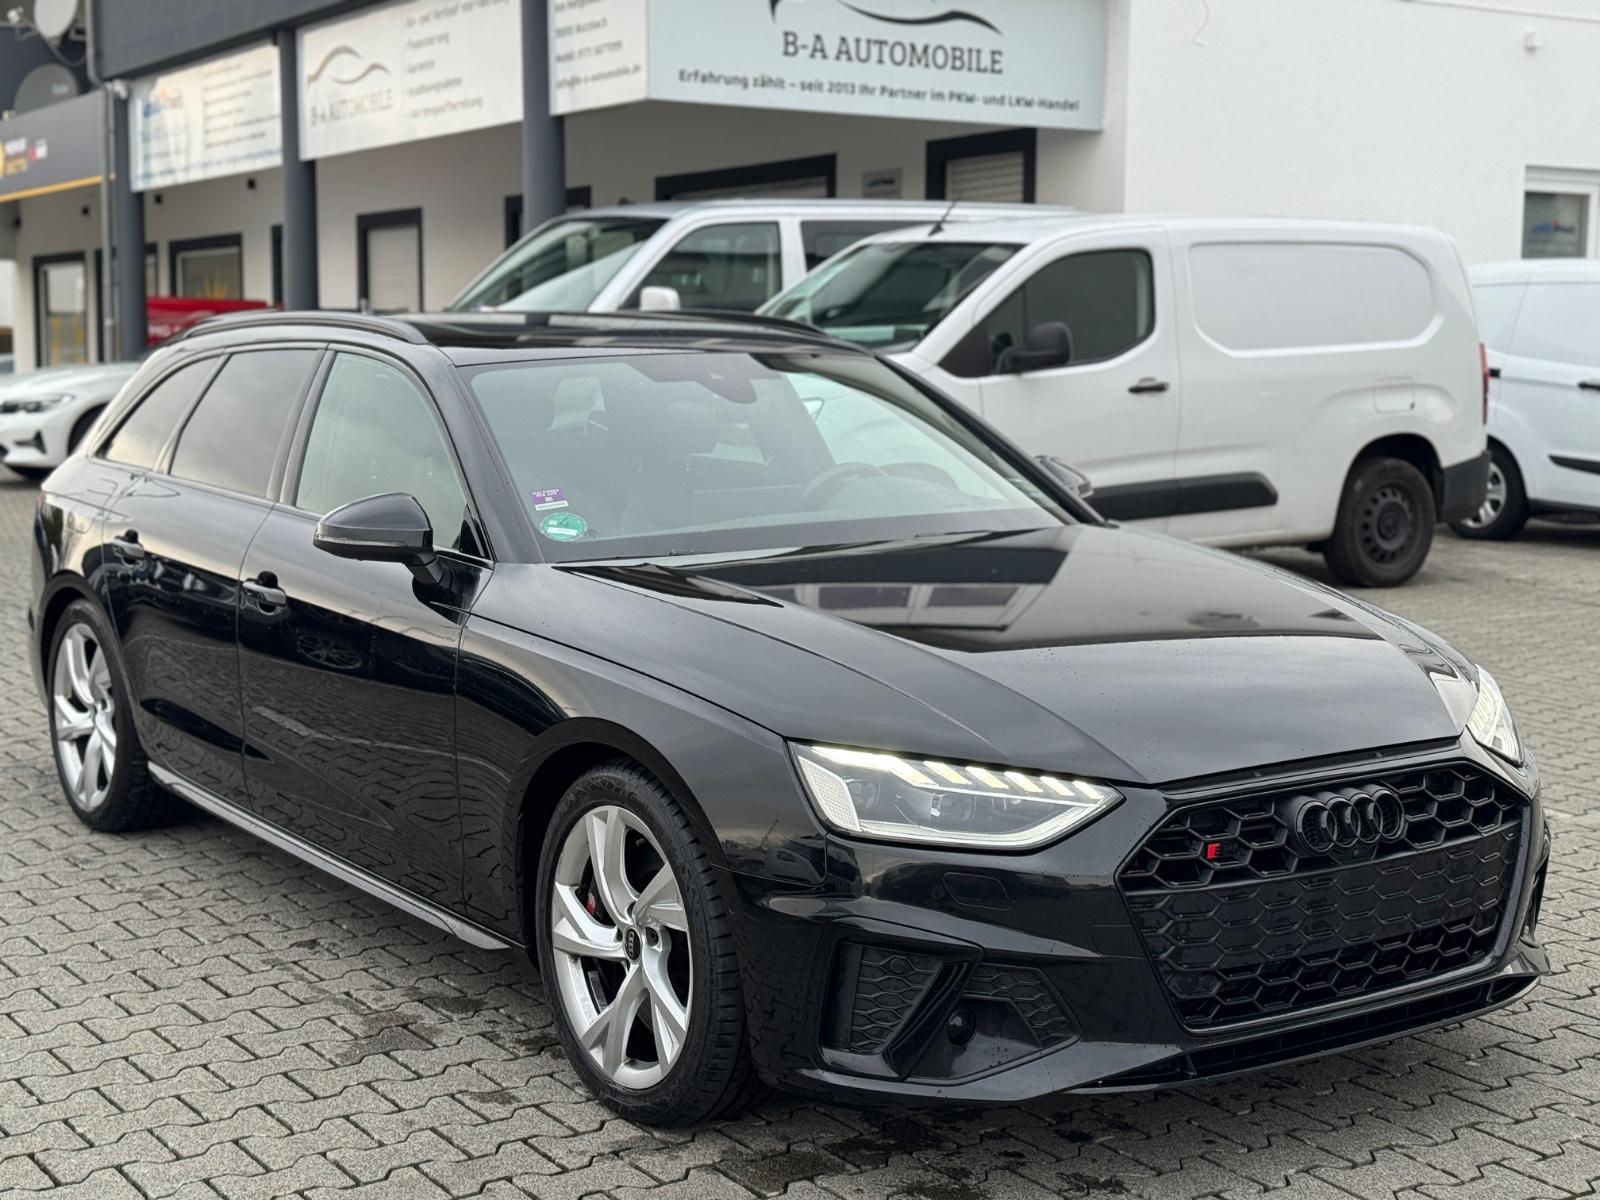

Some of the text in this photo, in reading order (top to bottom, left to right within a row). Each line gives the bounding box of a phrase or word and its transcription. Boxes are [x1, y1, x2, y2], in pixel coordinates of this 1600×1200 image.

[782, 31, 1004, 75] B-A AUTOMOBILE
[678, 69, 749, 90] Erfahrung
[753, 73, 786, 90] zählt
[799, 78, 824, 93] seit
[827, 81, 856, 96] 2013
[858, 82, 877, 97] Ihr
[879, 85, 928, 101] Partner
[930, 88, 946, 102] im
[982, 94, 1005, 107] und
[1008, 95, 1081, 112] LKW-Handel
